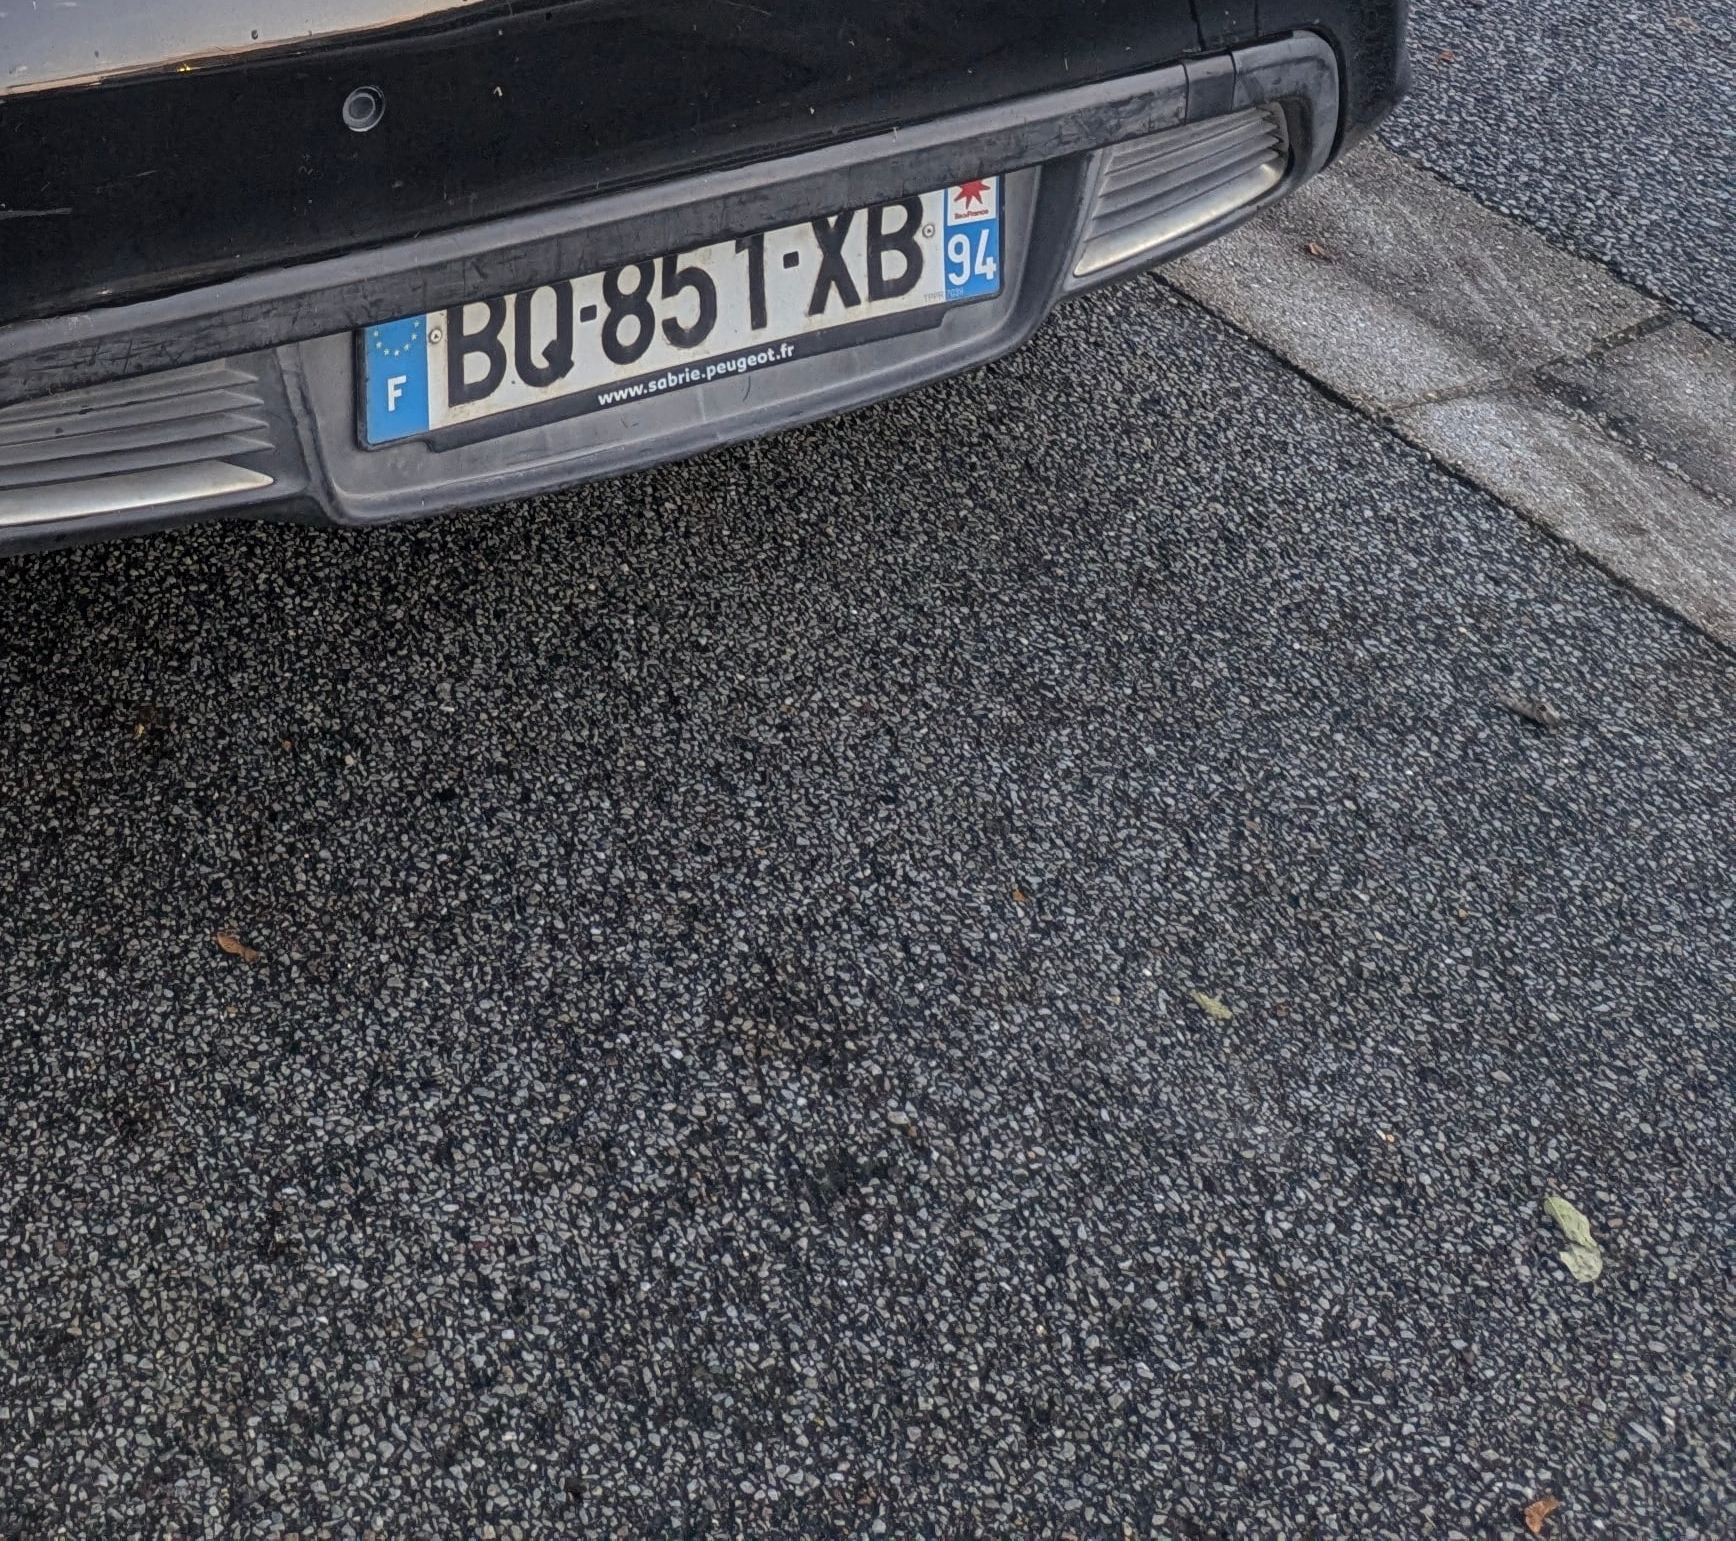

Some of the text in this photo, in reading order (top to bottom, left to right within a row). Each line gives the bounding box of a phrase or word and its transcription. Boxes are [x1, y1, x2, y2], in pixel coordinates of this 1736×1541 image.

[947, 228, 997, 286] 94
[446, 195, 926, 408] BQ-851-XB
[387, 375, 406, 412] F
[597, 342, 795, 406] www.sabrie.peugeot.fr
